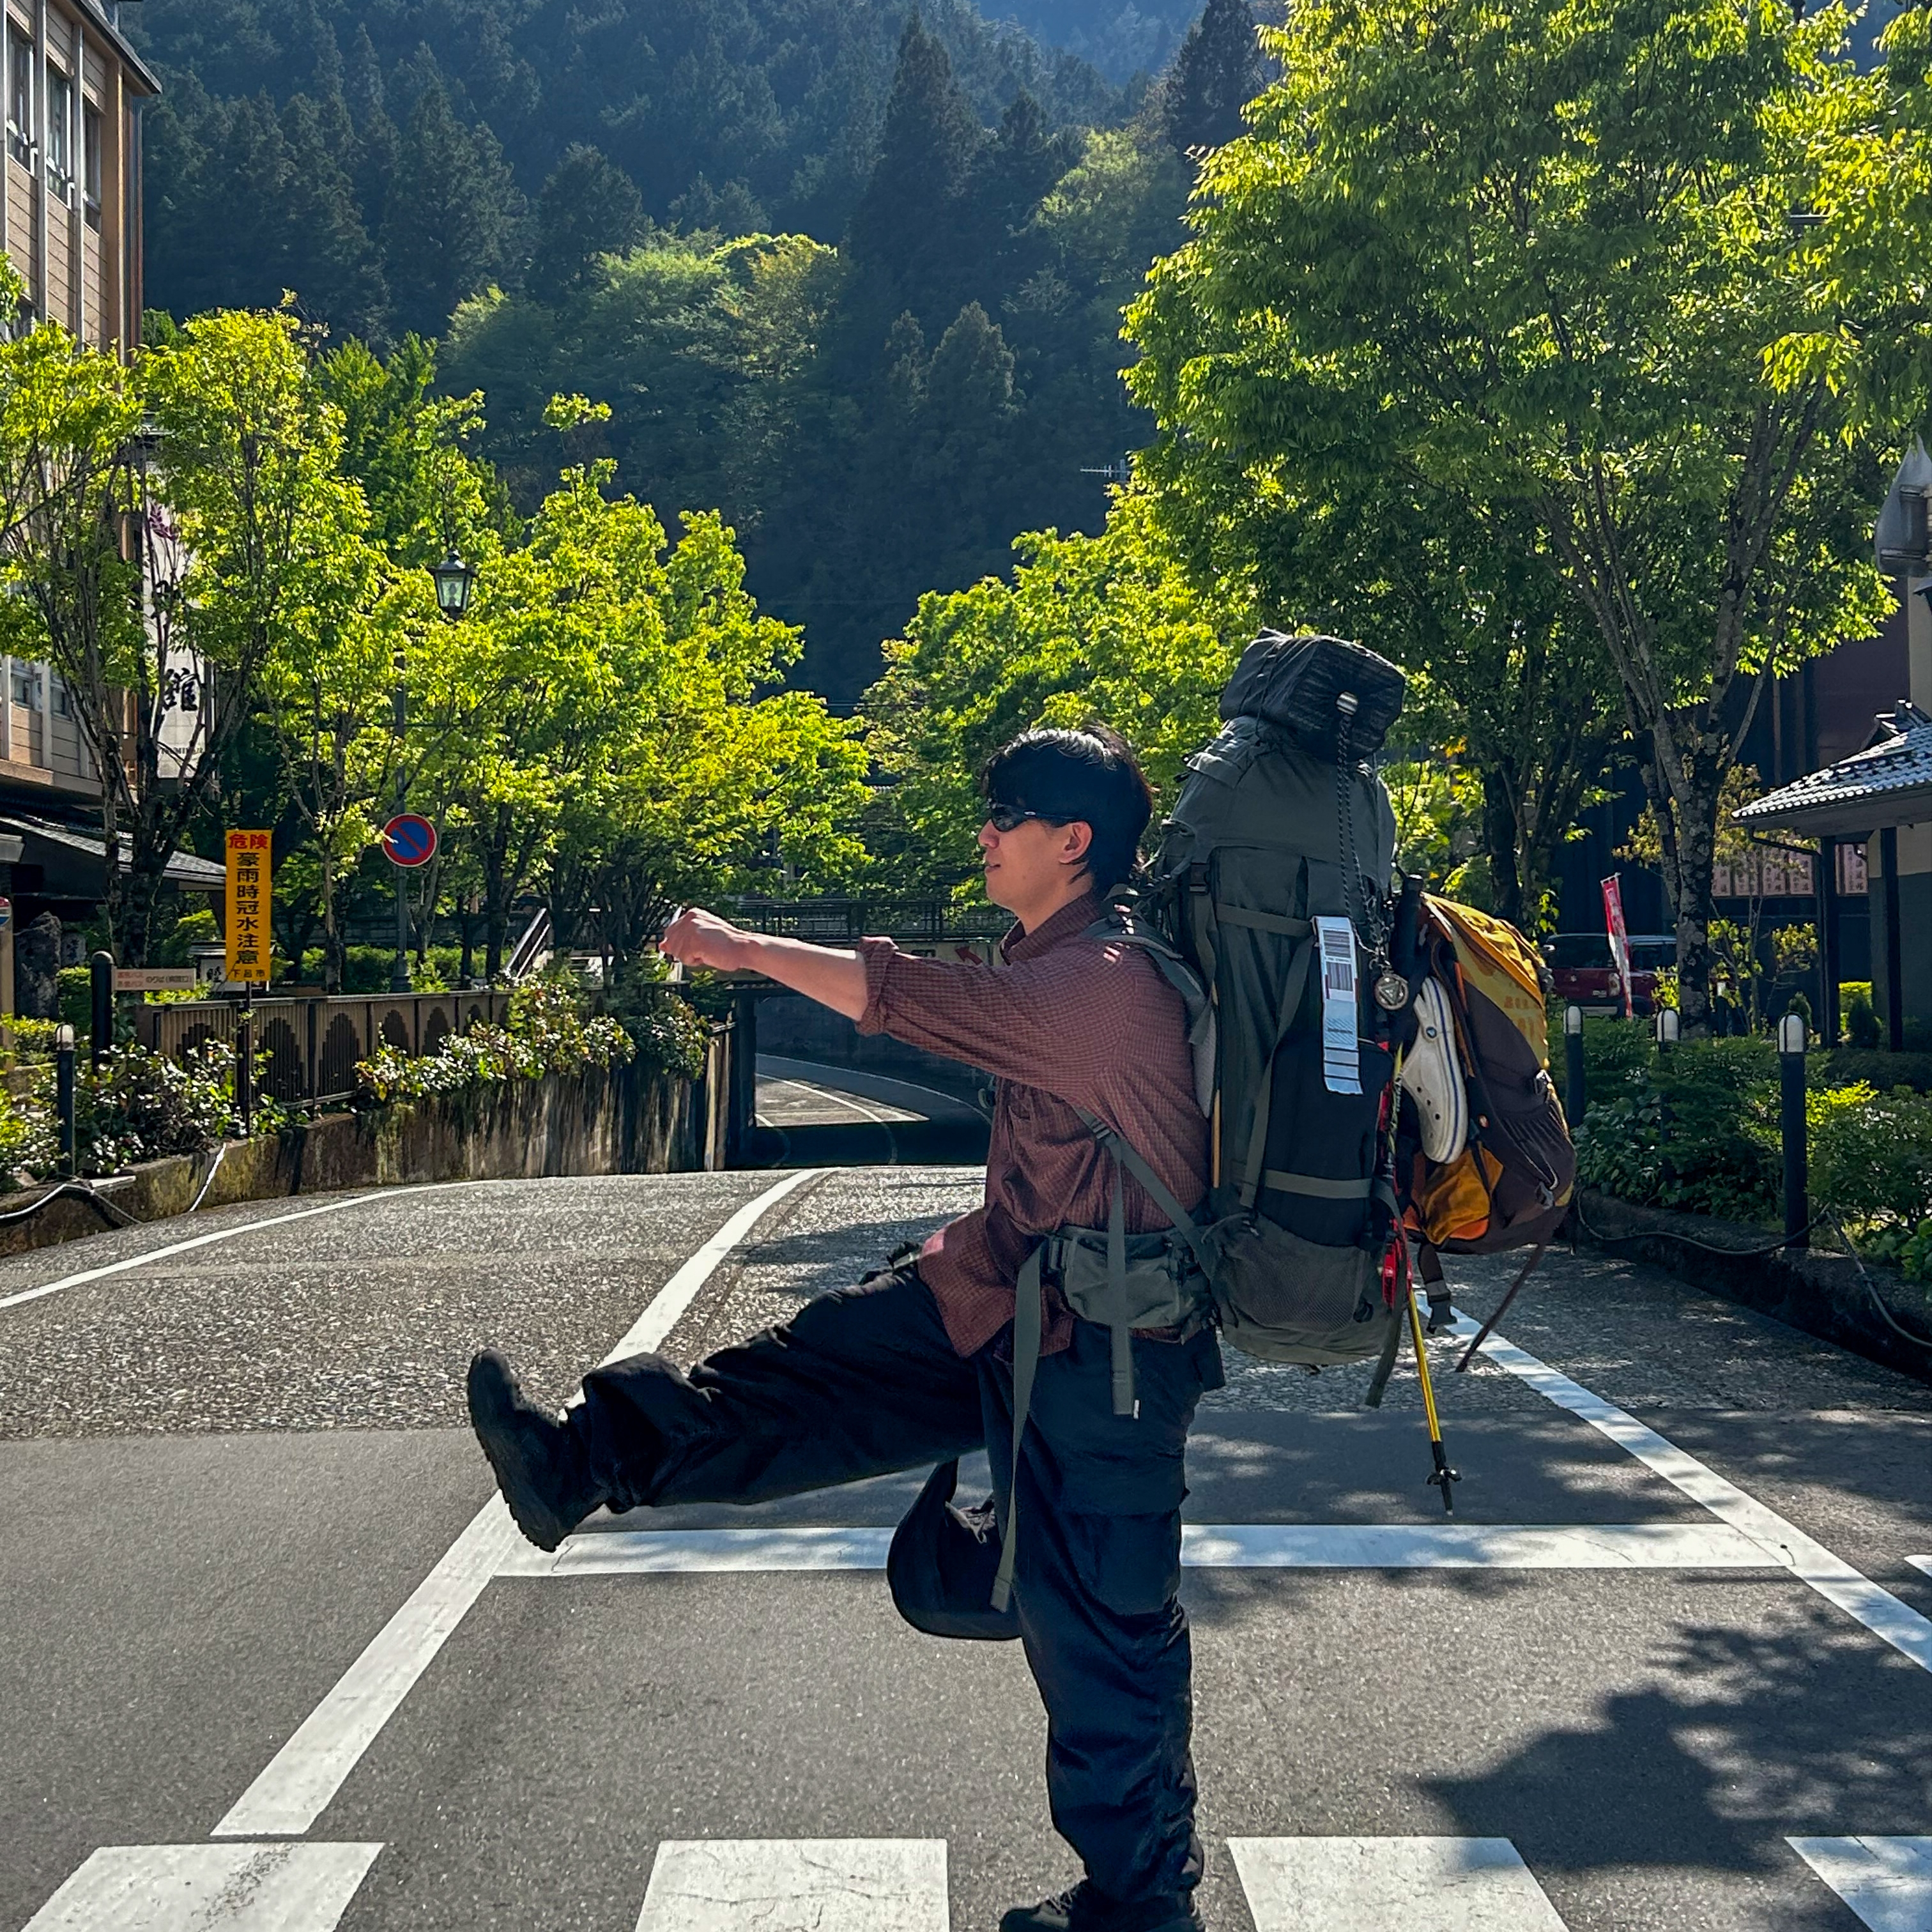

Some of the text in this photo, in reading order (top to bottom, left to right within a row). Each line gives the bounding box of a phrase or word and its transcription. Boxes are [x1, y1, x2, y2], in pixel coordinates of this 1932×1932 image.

[229, 834, 268, 849] 危険
[236, 852, 259, 964] 豪雨時冠水注意
[232, 969, 265, 977] 下呂市
